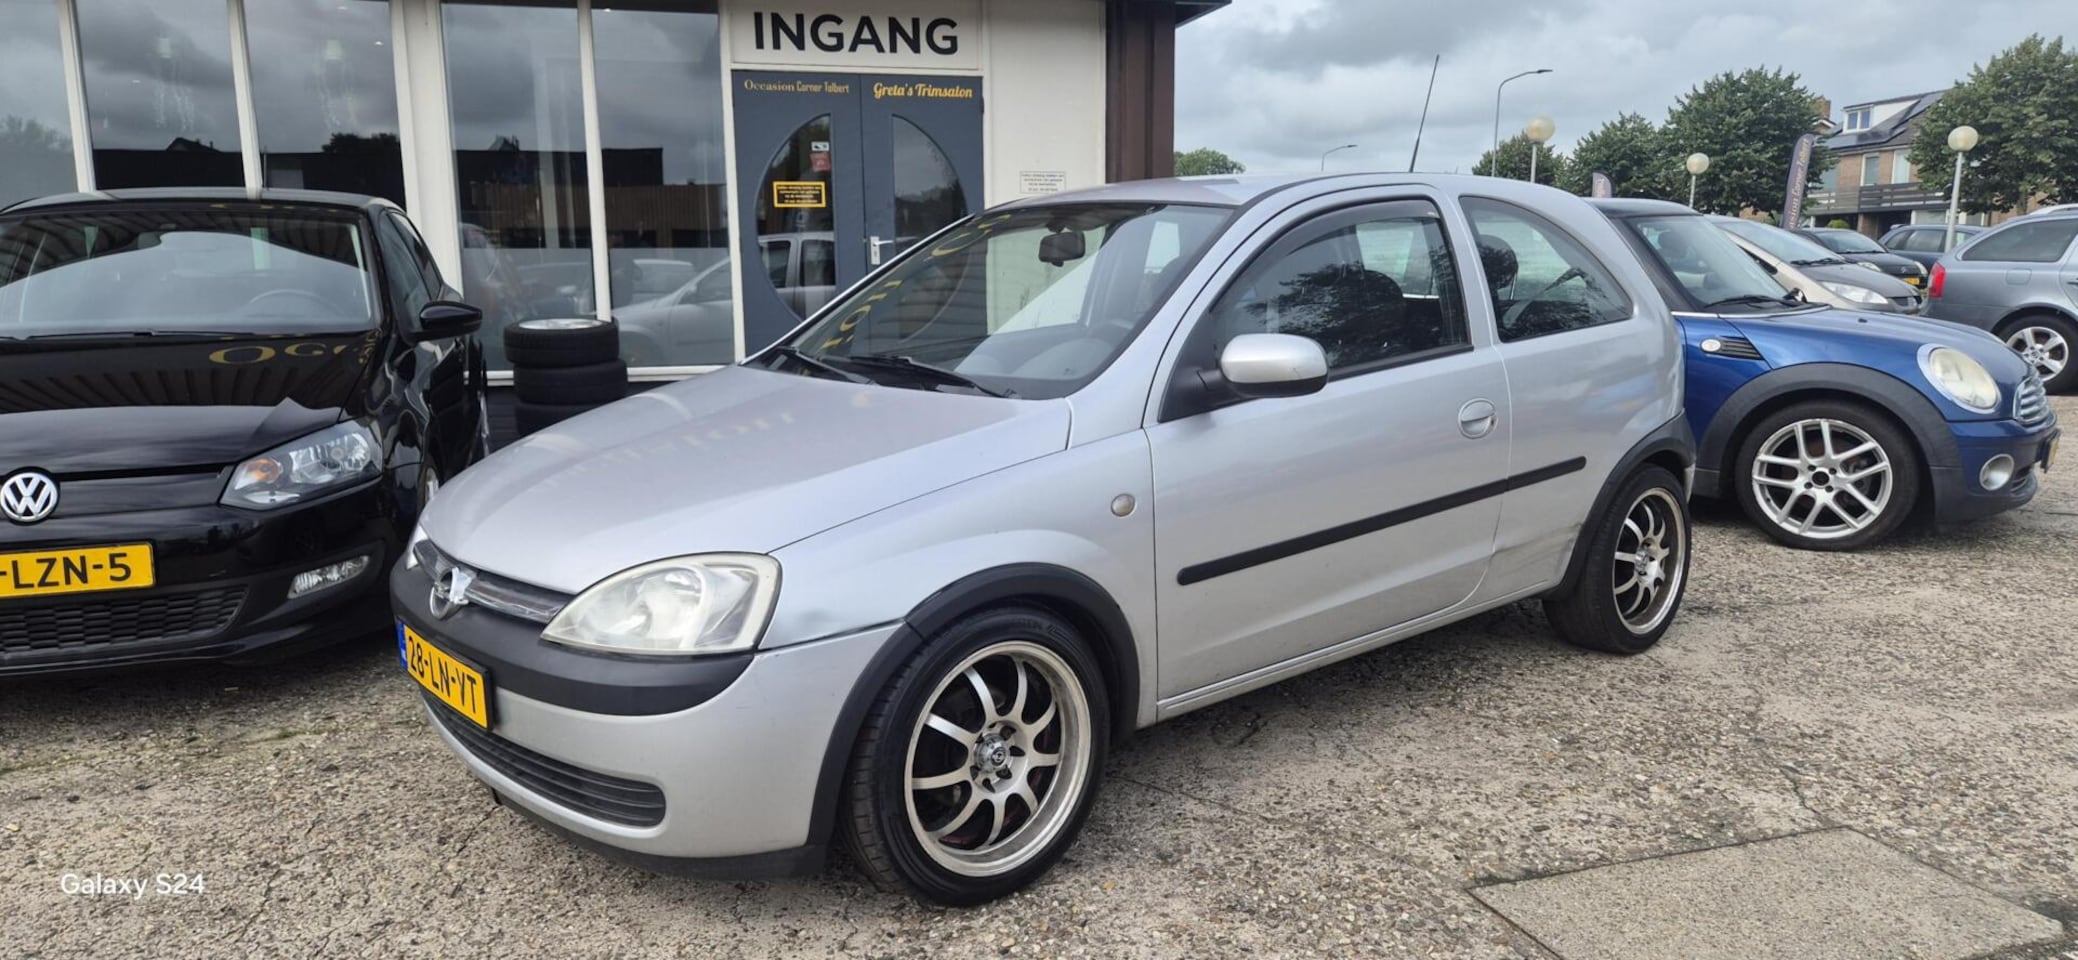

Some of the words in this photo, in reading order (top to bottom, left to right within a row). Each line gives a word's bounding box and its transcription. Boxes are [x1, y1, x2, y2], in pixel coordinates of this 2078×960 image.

[753, 11, 959, 55] INGANG
[743, 79, 795, 92] Occasion
[796, 80, 822, 92] Corner
[873, 81, 913, 100] Greta's
[915, 82, 973, 99] Trimsalon
[0, 552, 132, 590] -LZN-5
